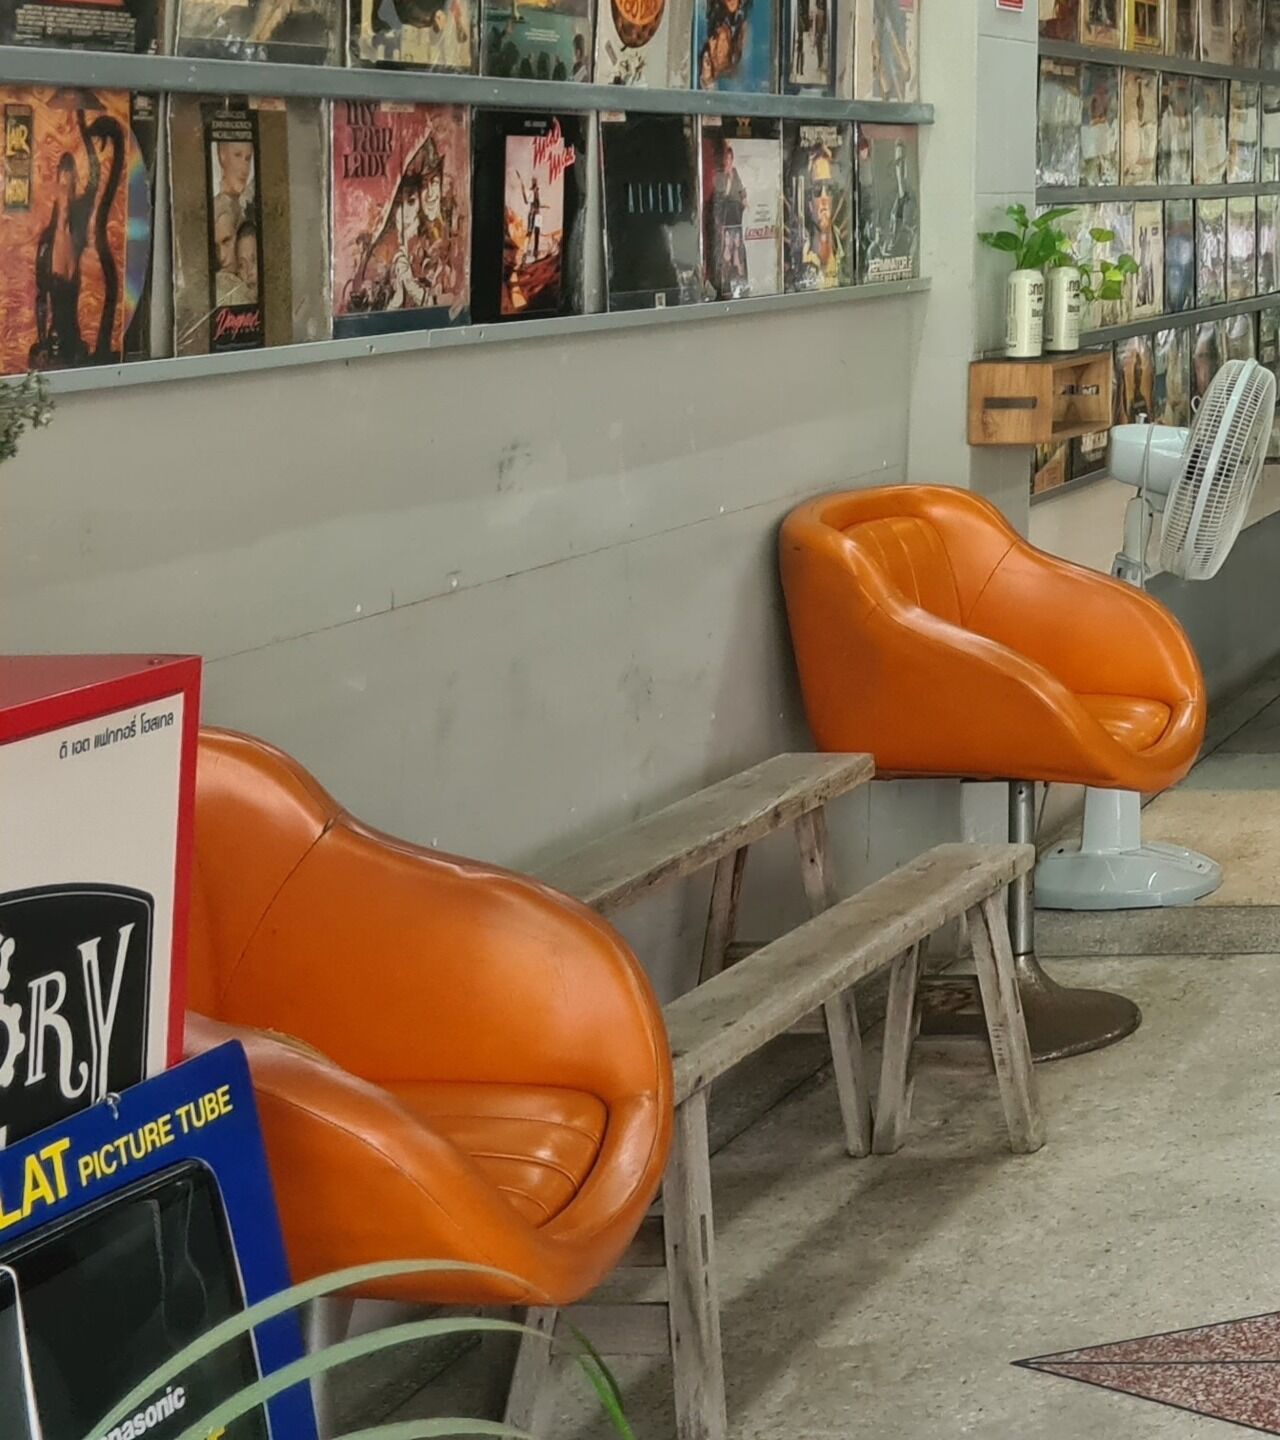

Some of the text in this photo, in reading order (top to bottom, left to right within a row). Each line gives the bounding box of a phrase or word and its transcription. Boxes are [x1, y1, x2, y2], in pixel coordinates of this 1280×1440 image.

[627, 181, 683, 214] ALIENS
[77, 1112, 175, 1188] PICTURE
[175, 1084, 234, 1134] TUBE
